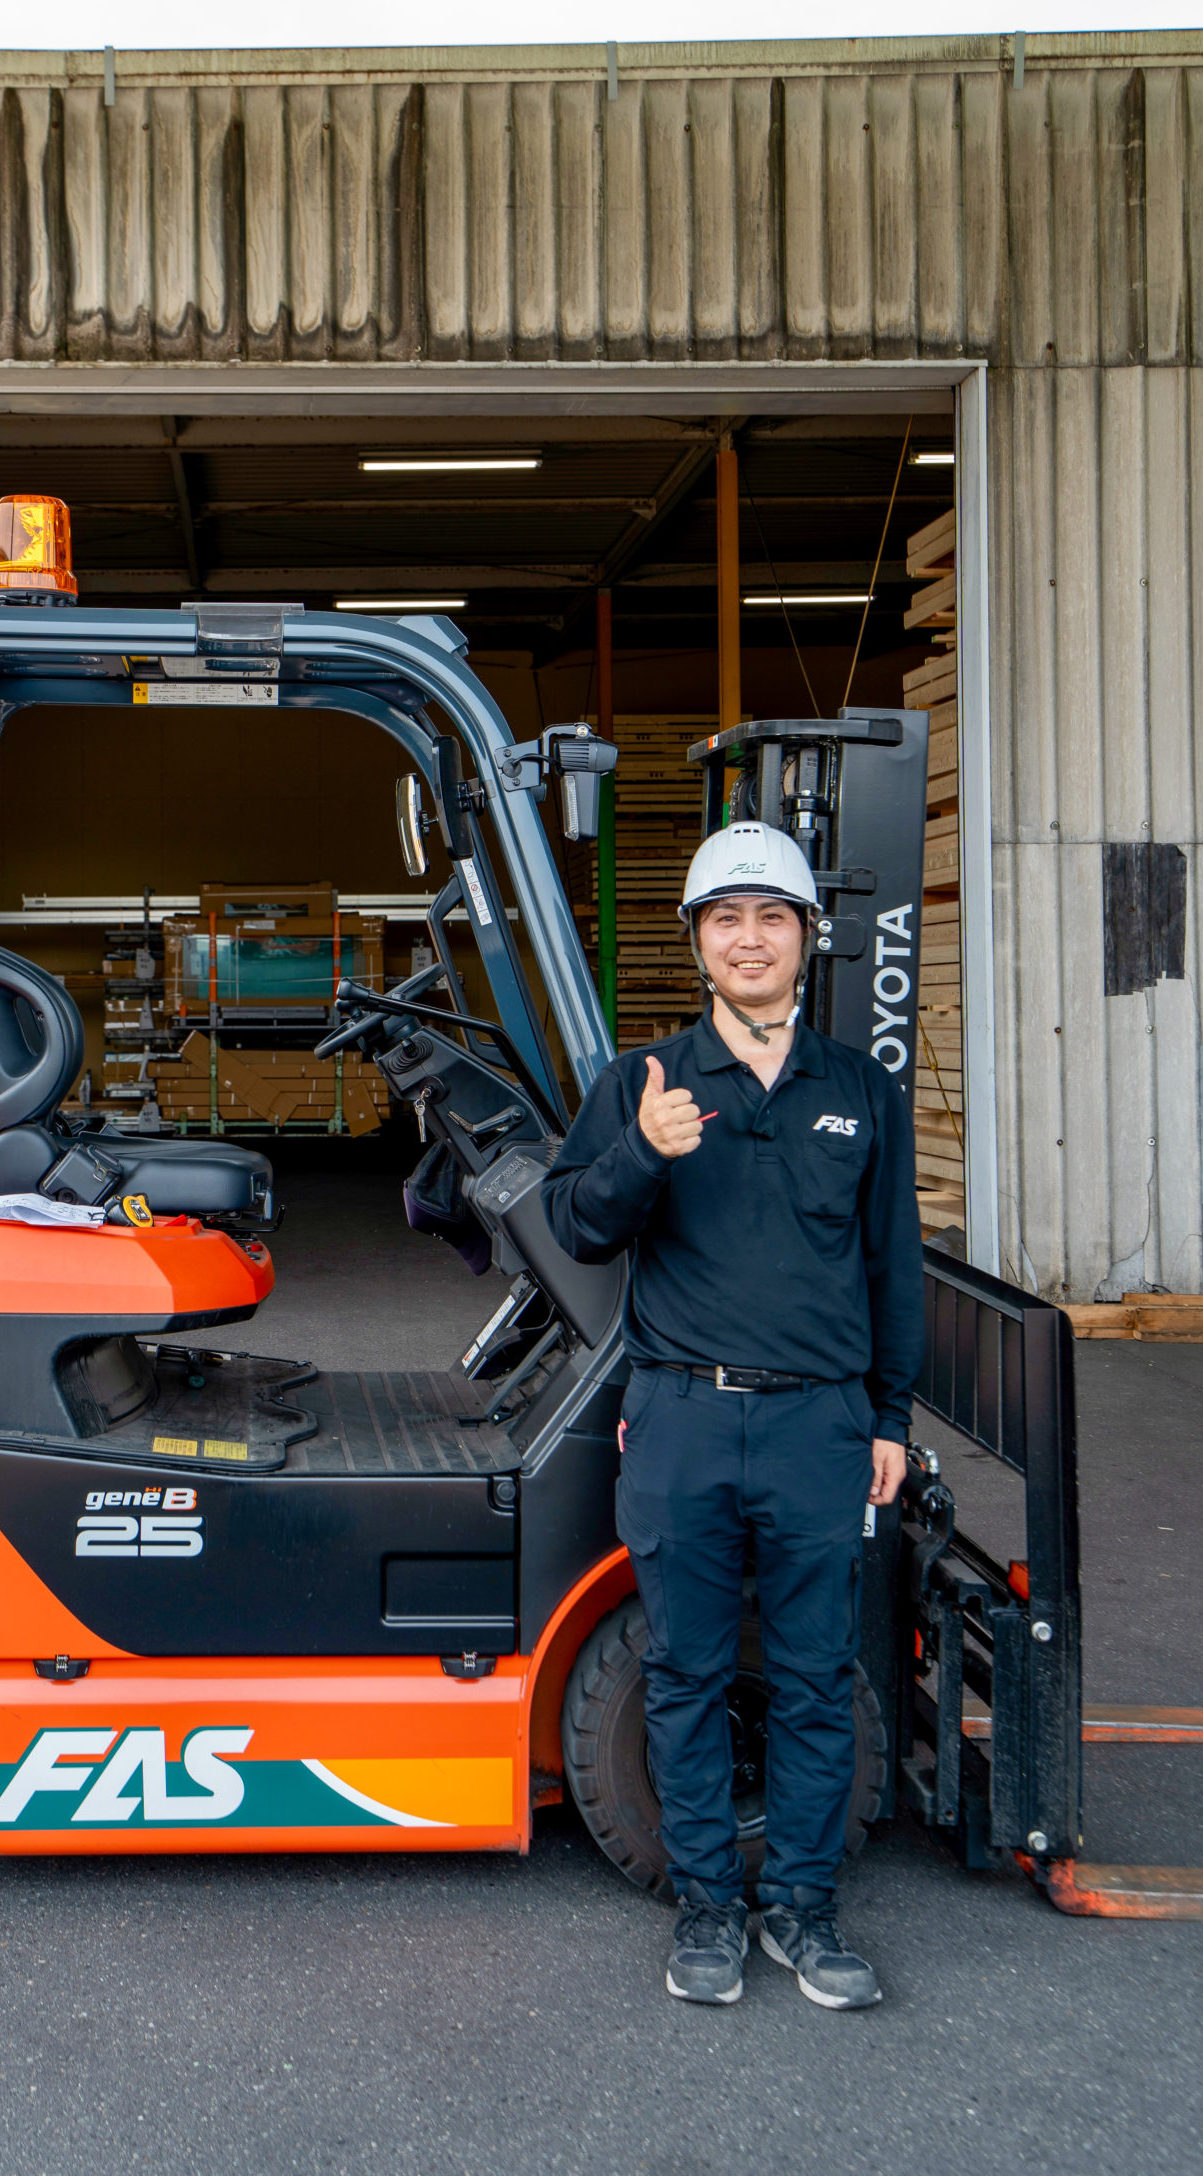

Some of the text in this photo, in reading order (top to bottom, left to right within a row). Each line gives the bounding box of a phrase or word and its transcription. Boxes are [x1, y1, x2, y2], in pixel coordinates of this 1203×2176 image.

[728, 862, 767, 875] FAS
[871, 903, 914, 1092] OYOTA
[812, 1115, 859, 1136] FAS
[75, 1516, 203, 1557] 25
[0, 1728, 255, 1822] FAS
